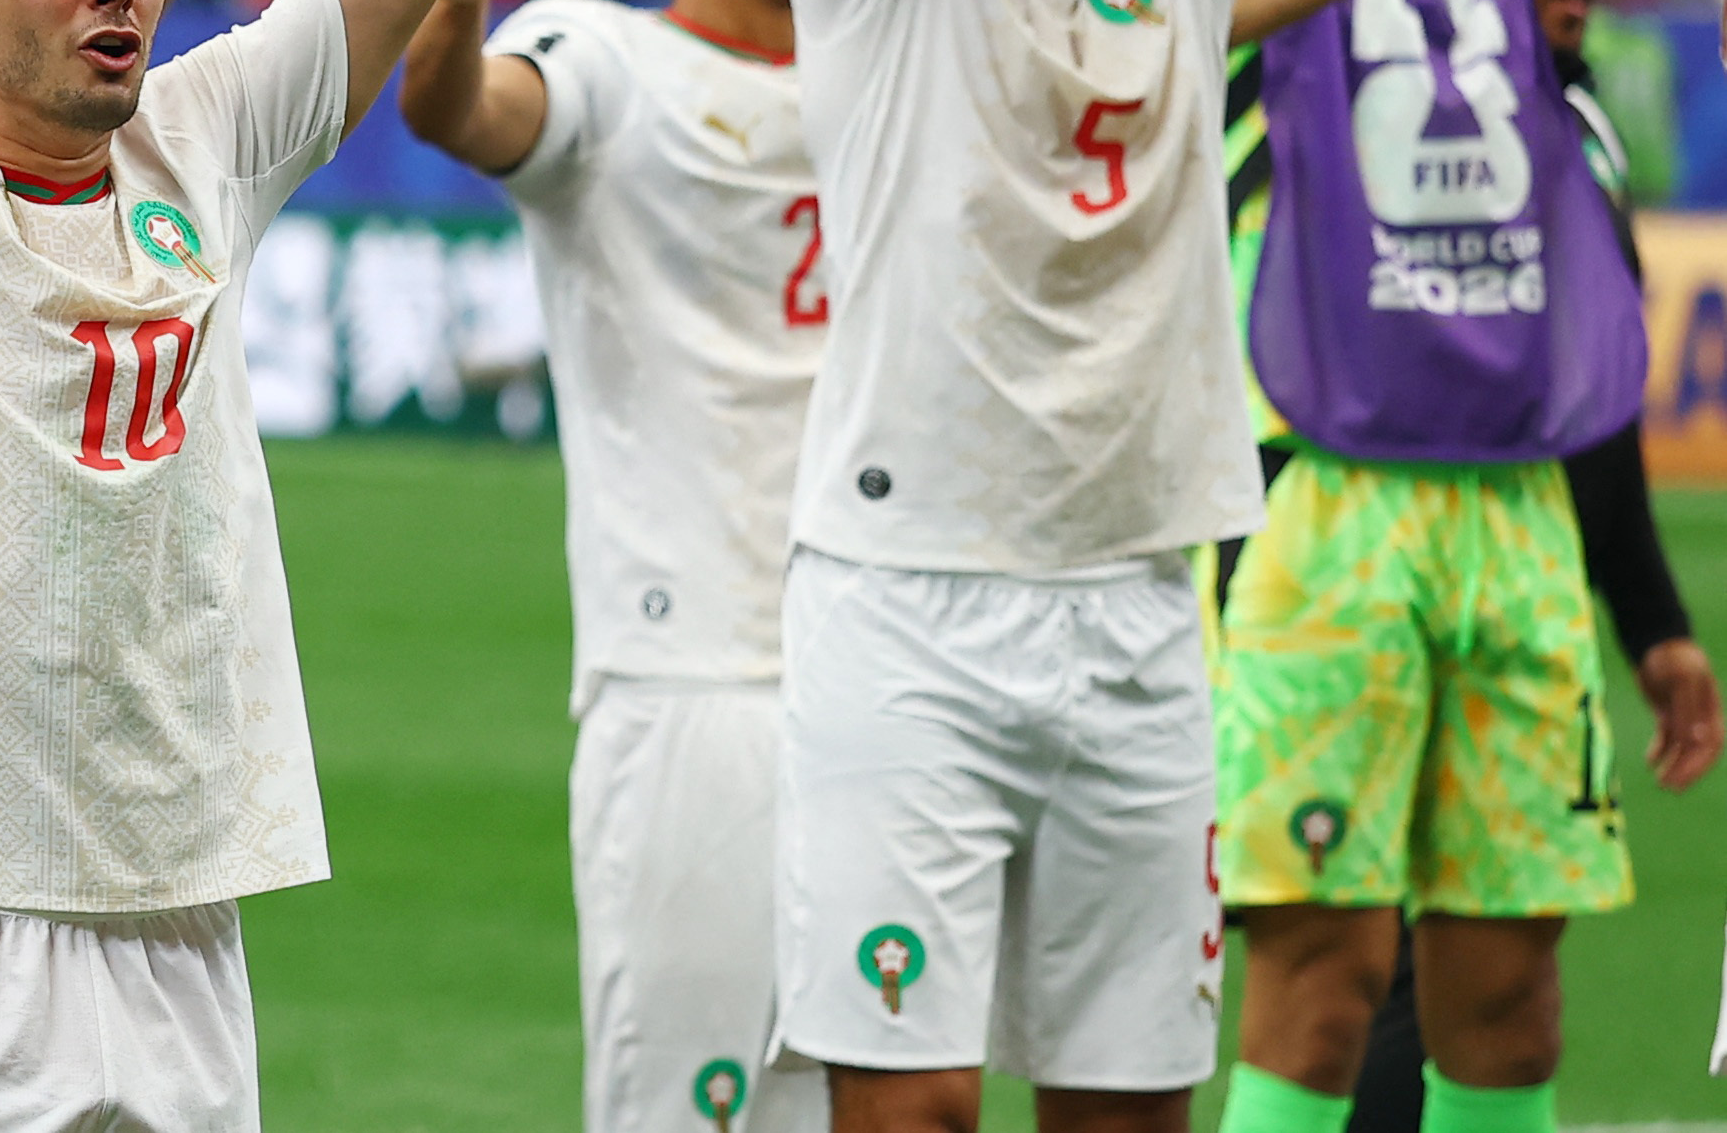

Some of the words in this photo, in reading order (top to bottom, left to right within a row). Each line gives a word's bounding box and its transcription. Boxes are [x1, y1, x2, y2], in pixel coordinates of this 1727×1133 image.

[1071, 97, 1145, 215] 5
[1414, 160, 1496, 194] FIFA
[1367, 260, 1548, 316] 2026
[70, 317, 195, 471] 10
